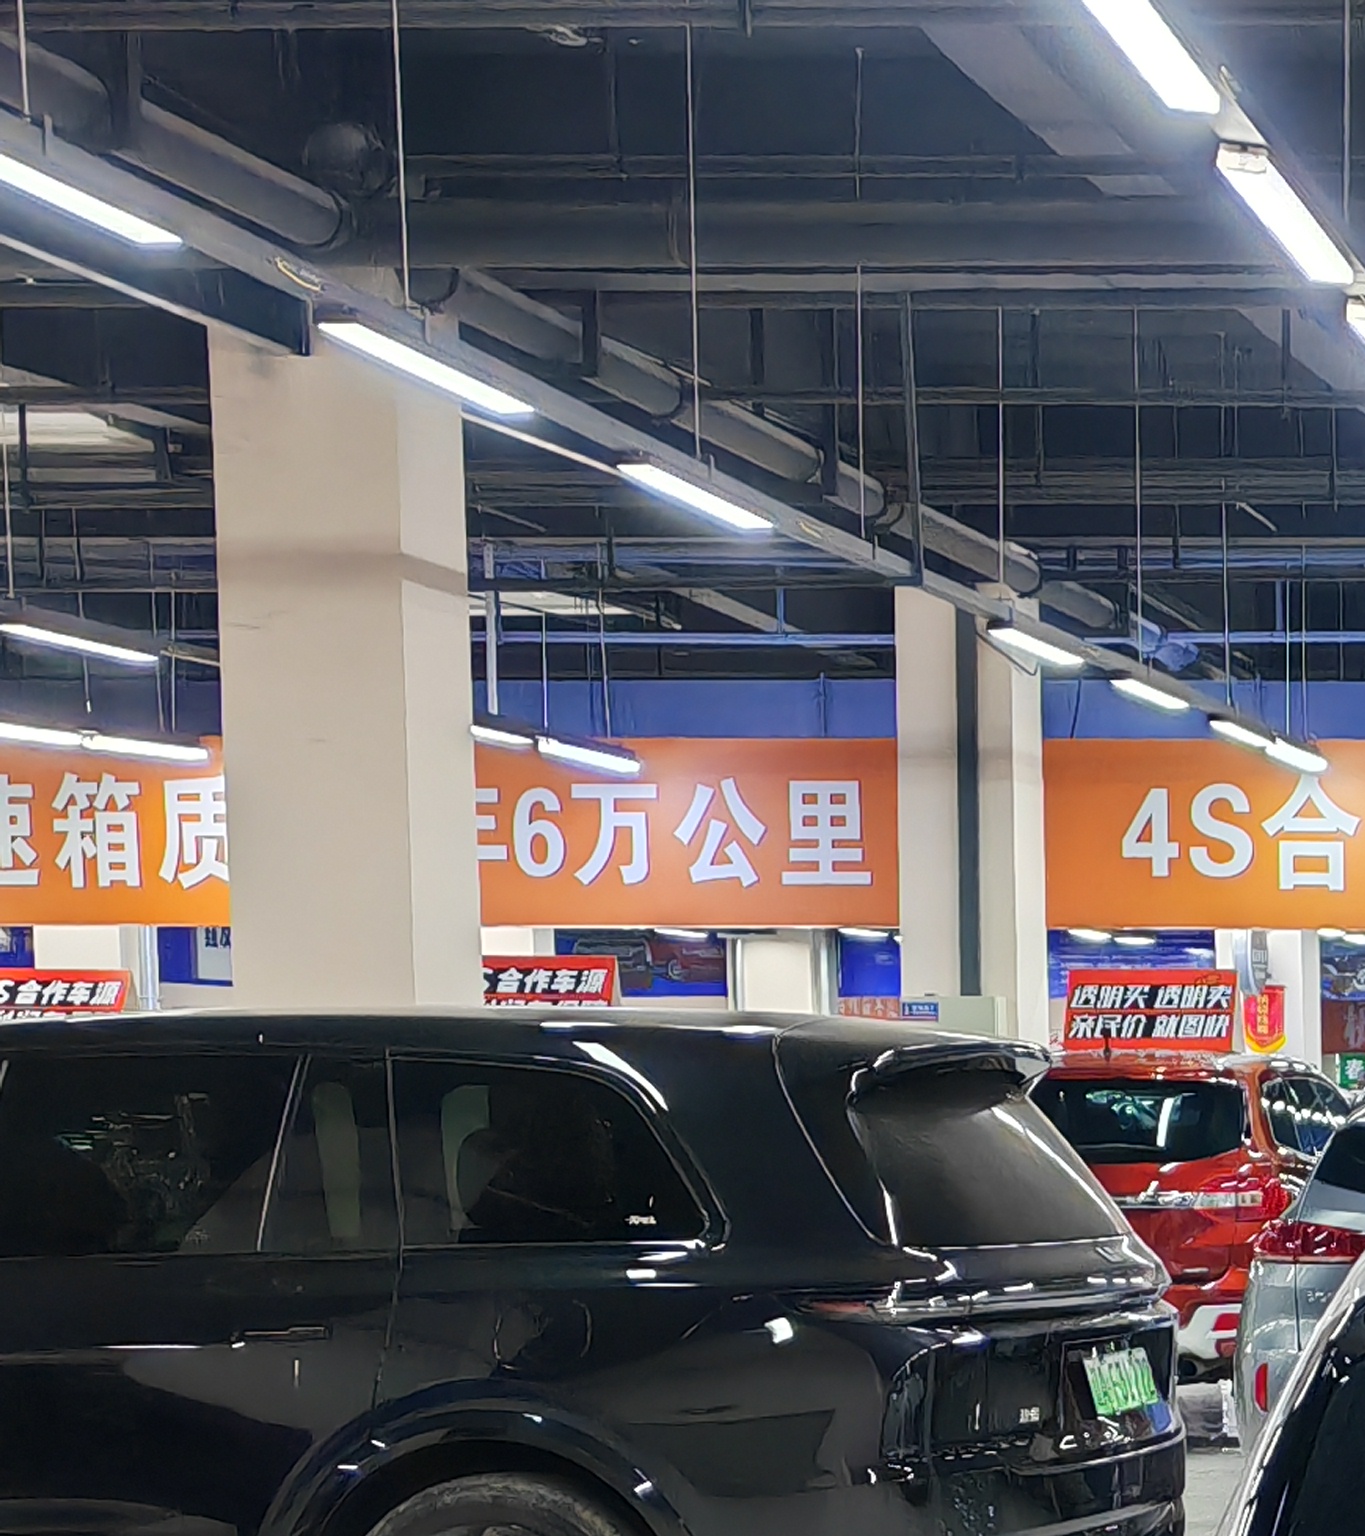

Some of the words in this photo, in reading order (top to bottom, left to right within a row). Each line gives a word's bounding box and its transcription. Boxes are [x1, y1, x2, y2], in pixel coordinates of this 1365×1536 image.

[1069, 984, 1151, 1009] 透明买
[1153, 984, 1233, 1009] 透明卖
[1068, 1014, 1147, 1039] 亲民价
[1152, 1014, 1229, 1039] 就图快
